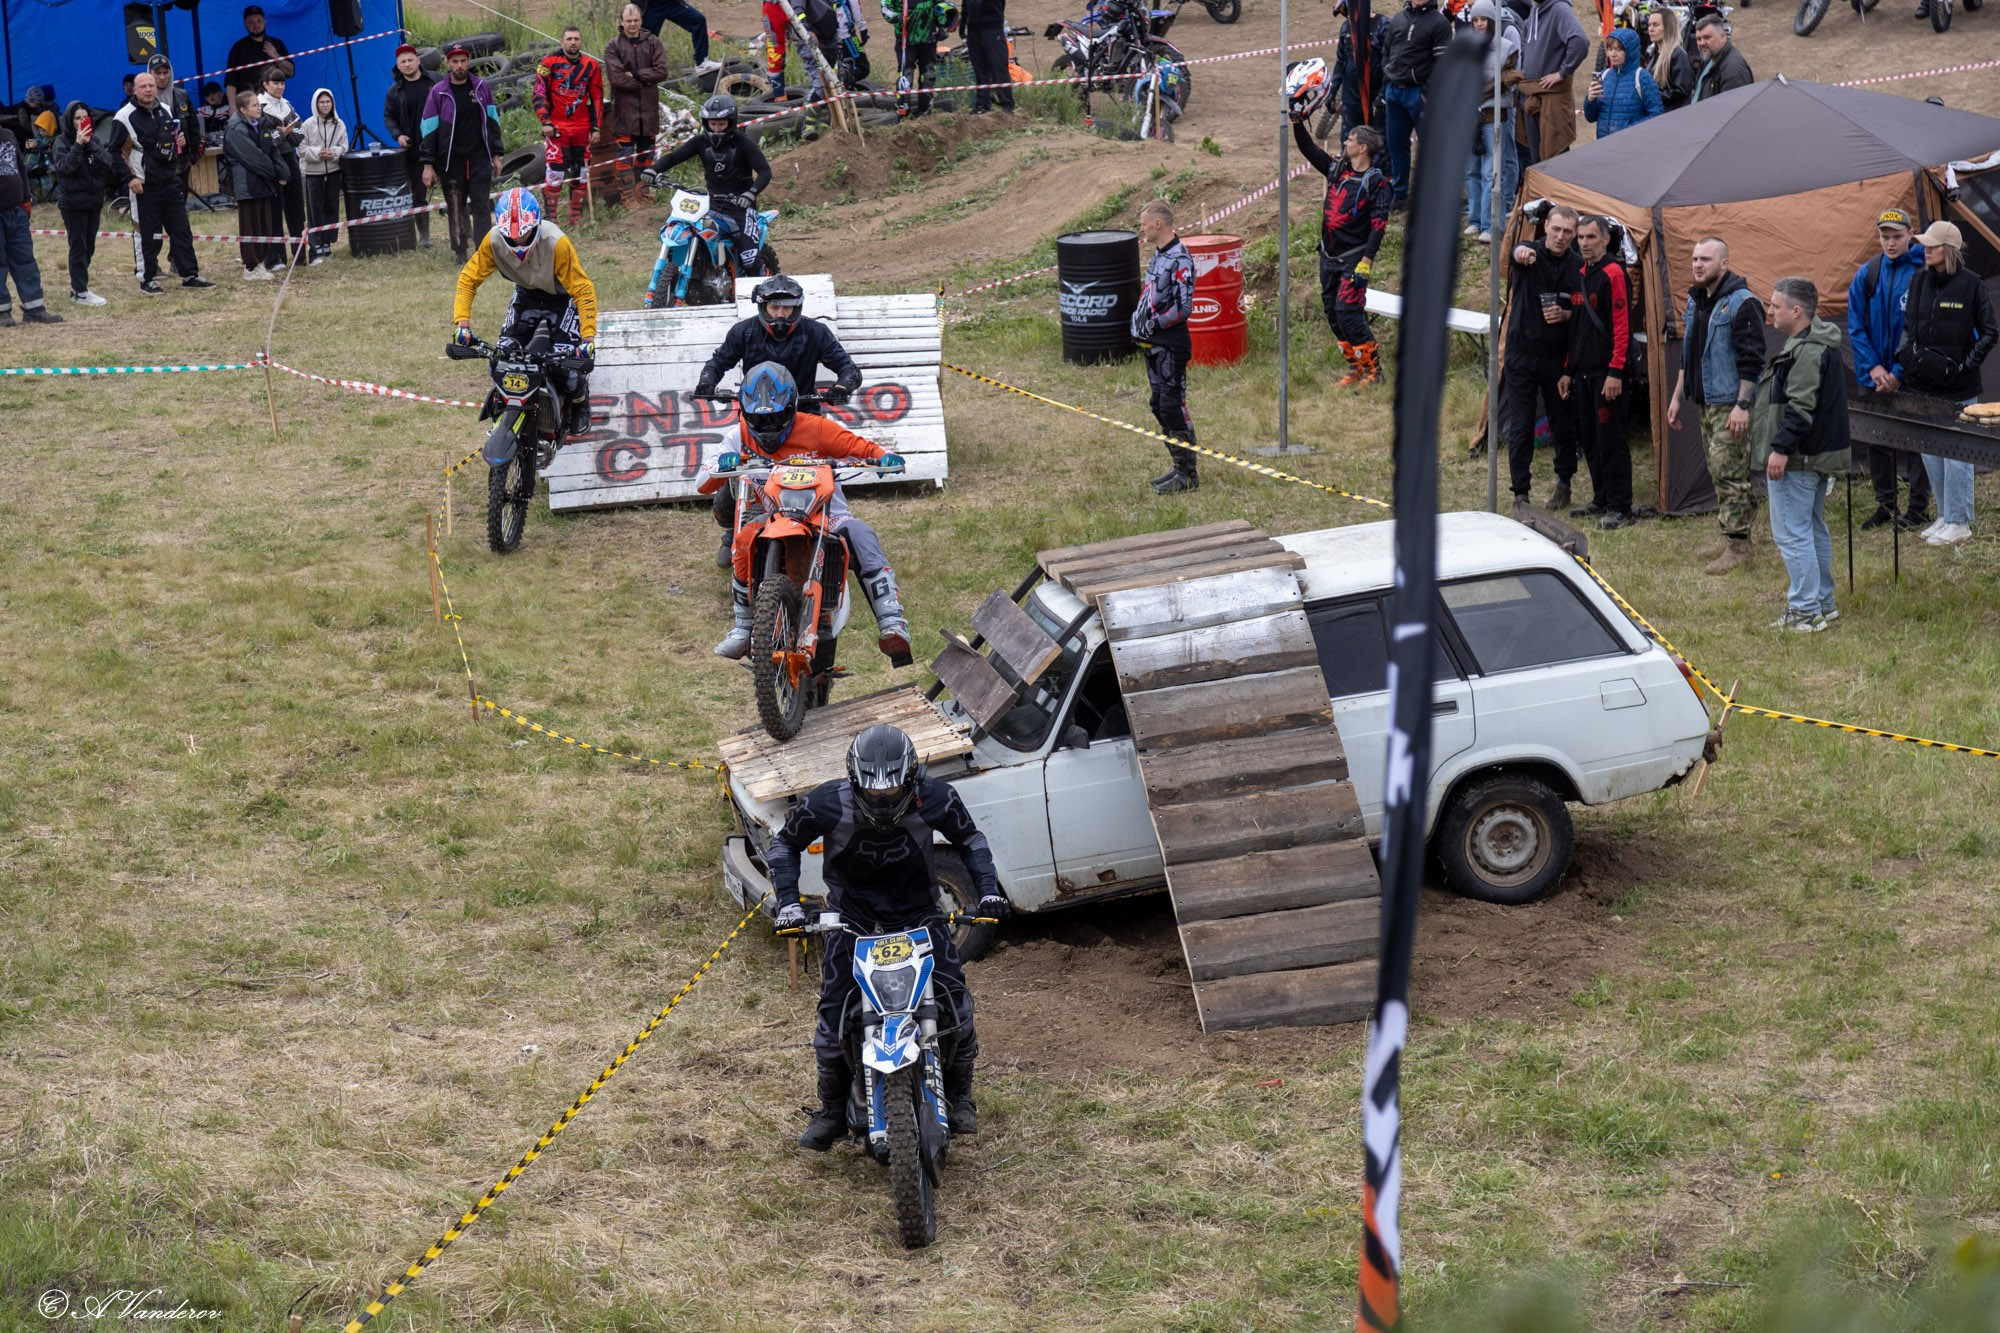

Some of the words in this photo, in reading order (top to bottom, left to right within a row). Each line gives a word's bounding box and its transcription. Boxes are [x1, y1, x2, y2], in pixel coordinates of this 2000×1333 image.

[360, 192, 413, 211] RECOR
[1060, 292, 1118, 309] ECORD
[1077, 308, 1108, 316] RADIO
[1071, 315, 1088, 323] 104.4
[510, 379, 520, 388] 14
[790, 473, 806, 481] 81
[882, 945, 901, 958] 62
